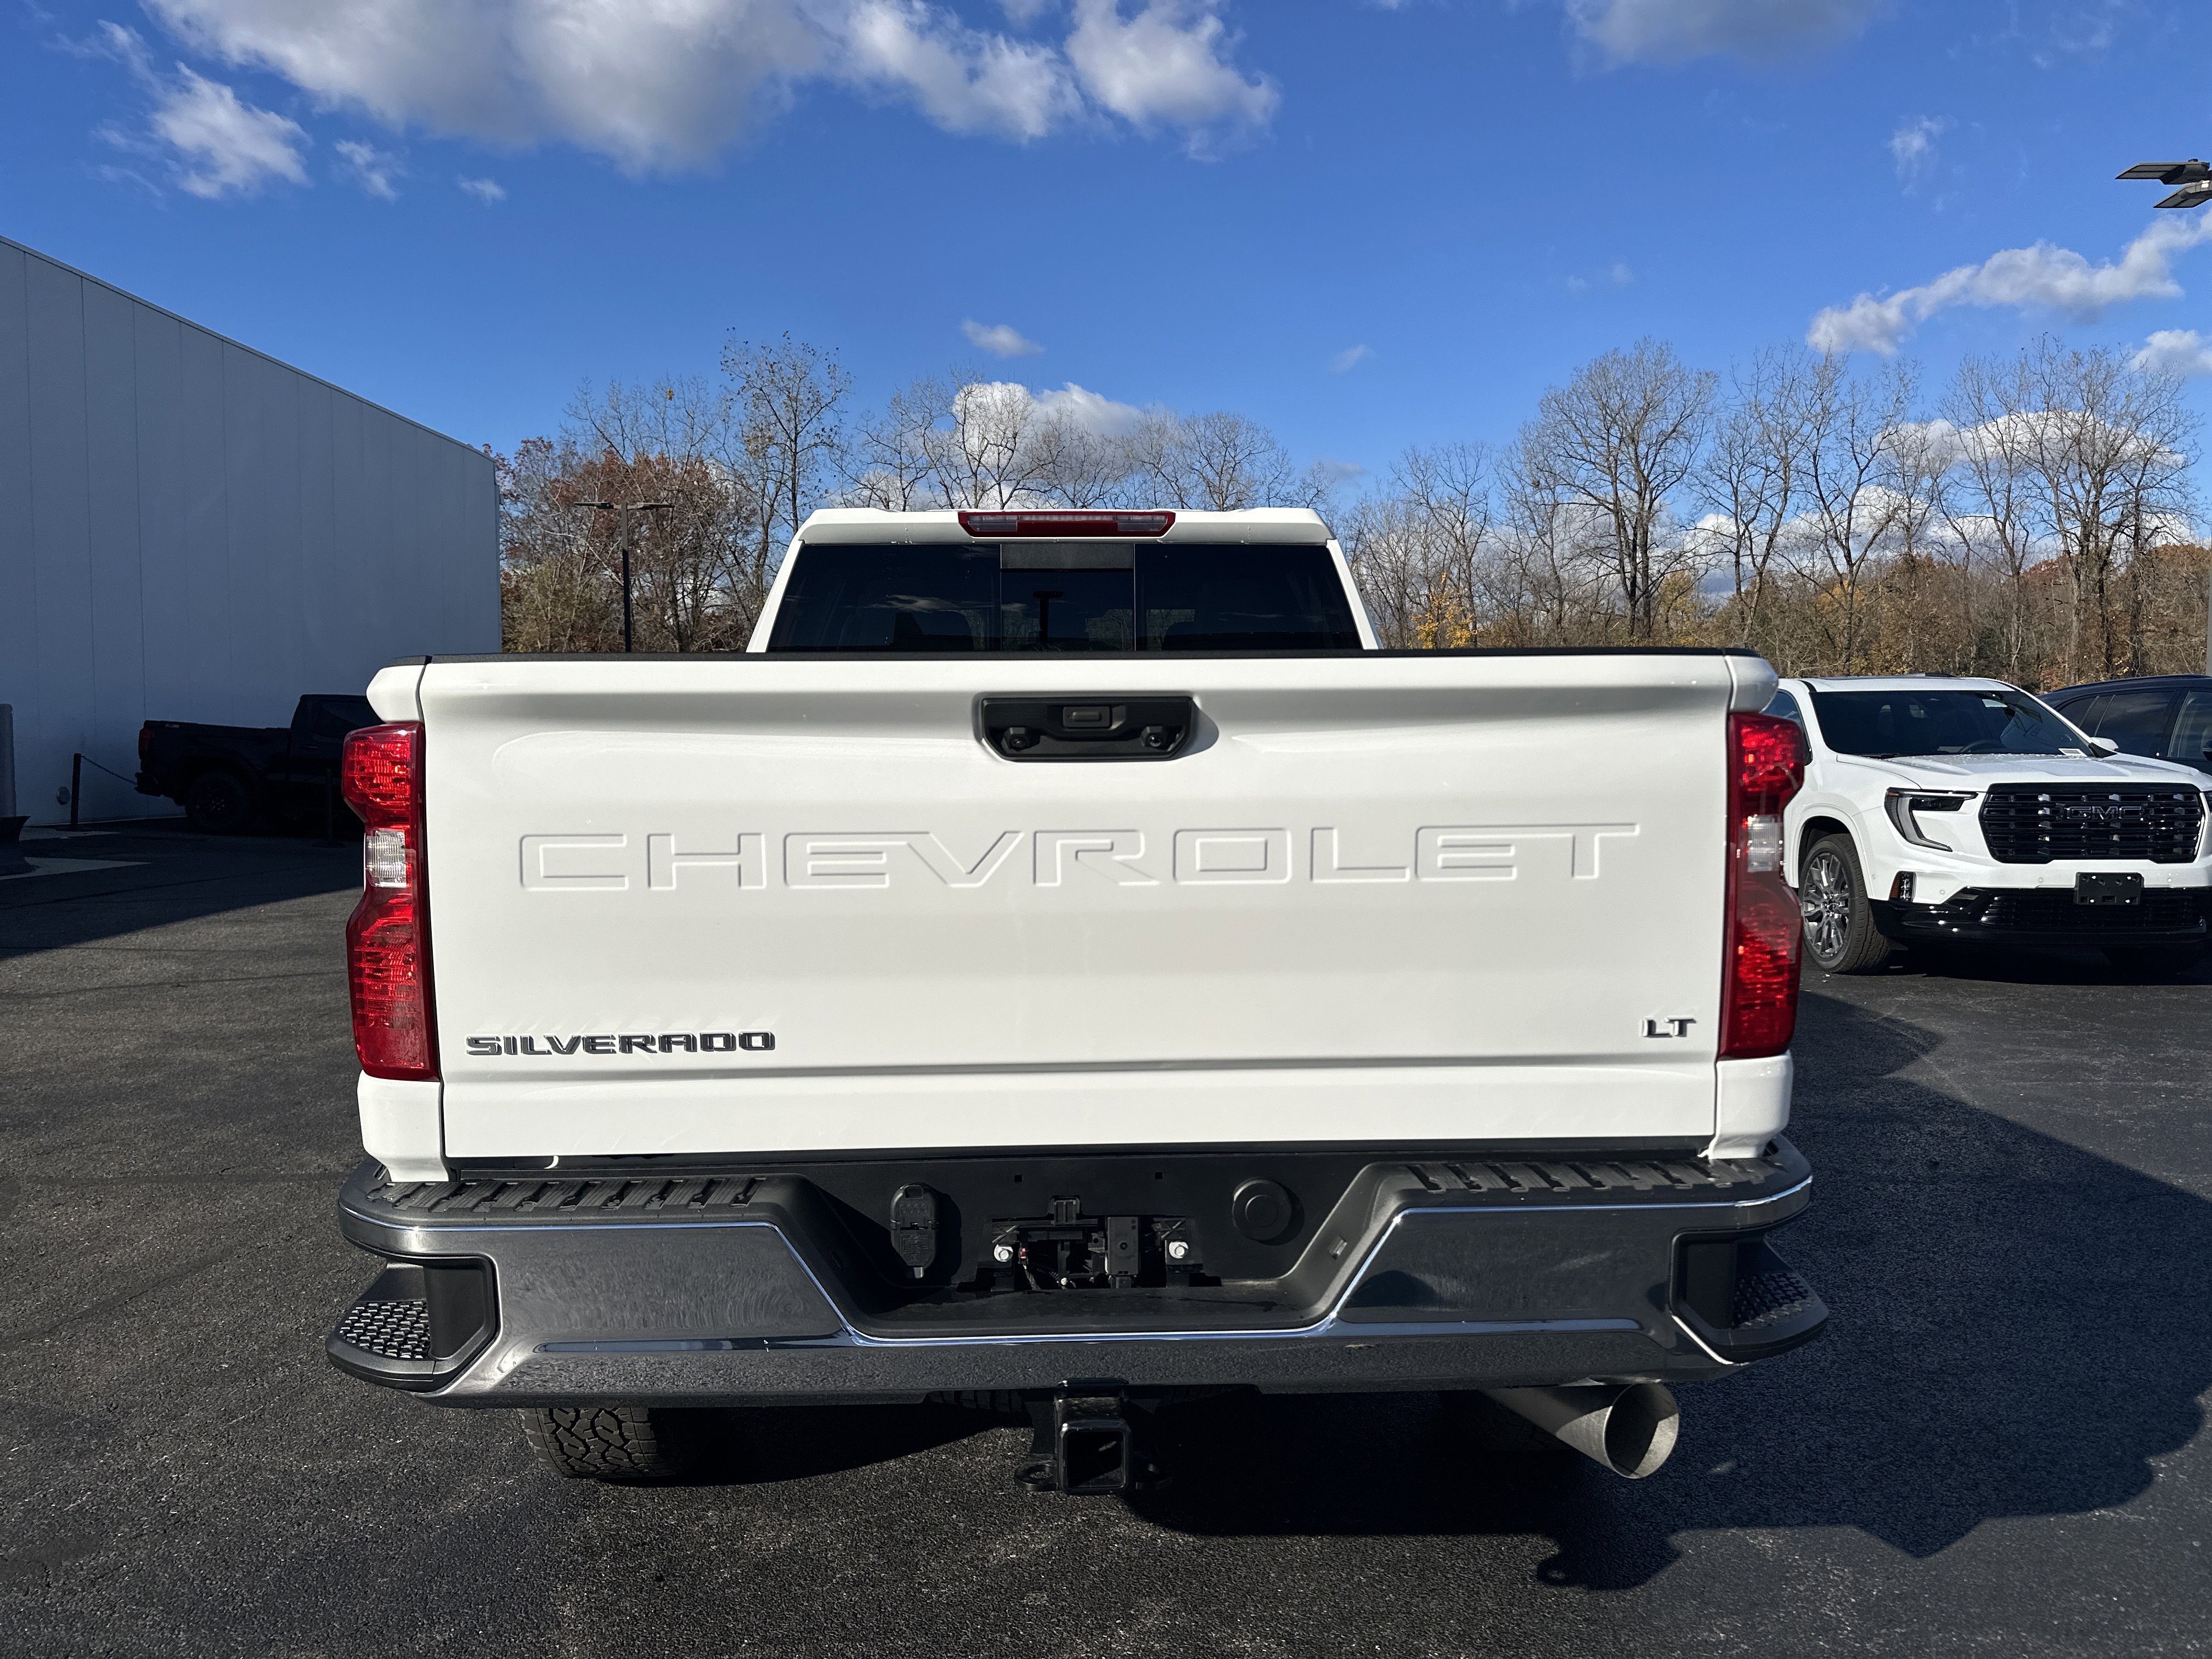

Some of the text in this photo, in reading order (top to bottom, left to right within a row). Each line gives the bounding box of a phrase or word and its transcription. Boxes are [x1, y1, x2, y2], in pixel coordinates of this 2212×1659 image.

[2067, 806, 2143, 820] GMC
[520, 823, 1641, 891] CHEVROLET
[1642, 1016, 1696, 1038] LT
[466, 1032, 776, 1056] SILVERADO
